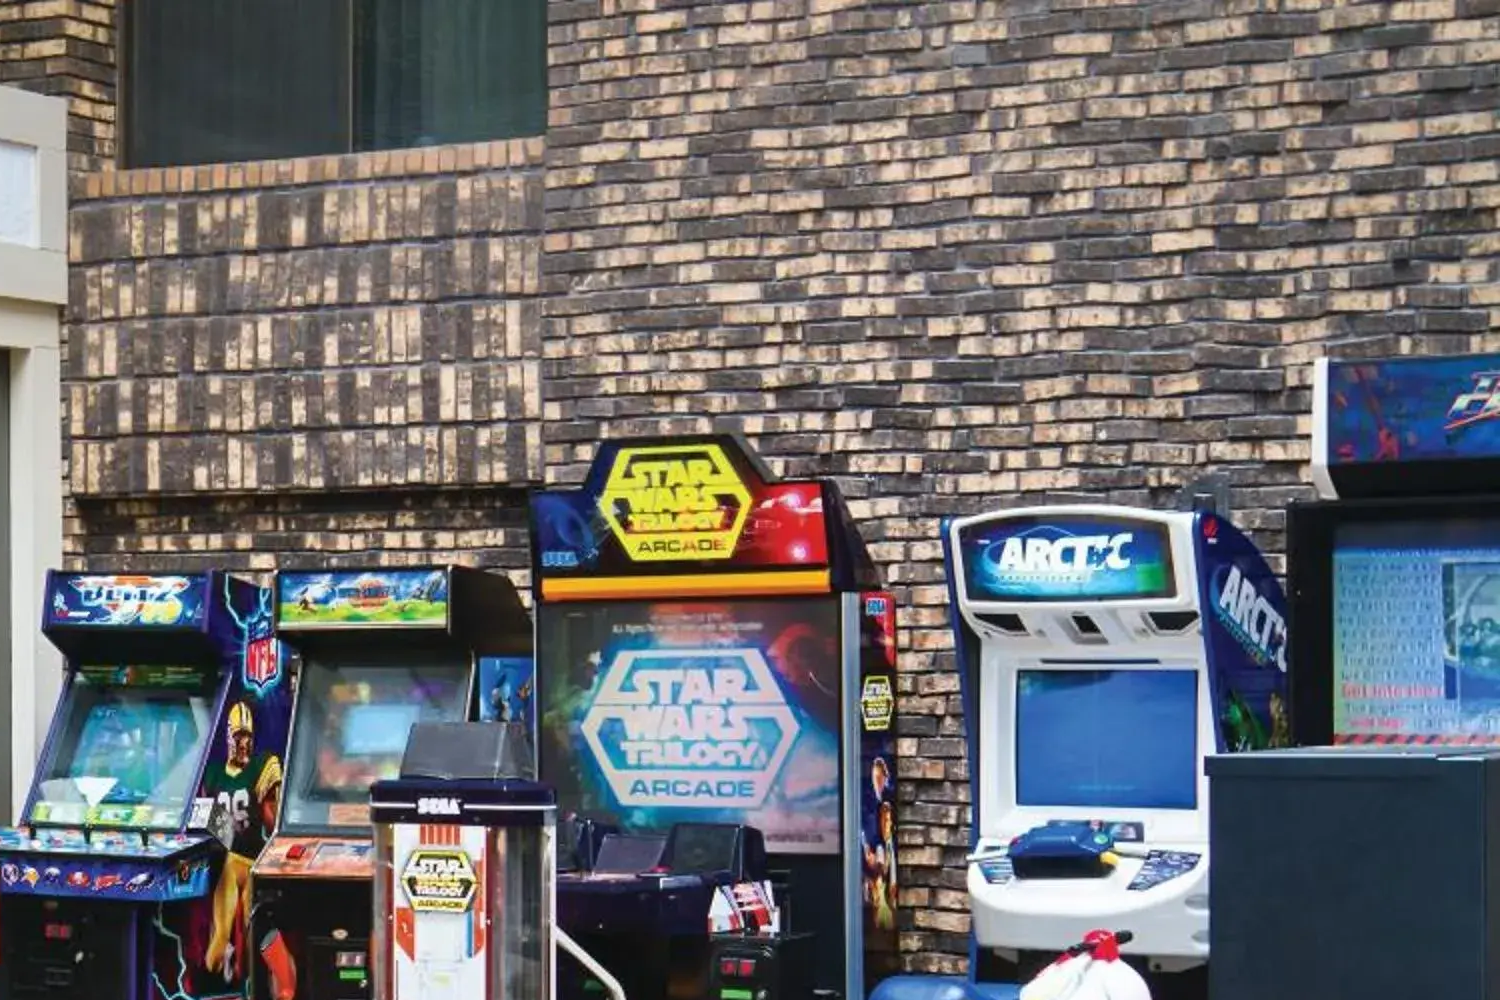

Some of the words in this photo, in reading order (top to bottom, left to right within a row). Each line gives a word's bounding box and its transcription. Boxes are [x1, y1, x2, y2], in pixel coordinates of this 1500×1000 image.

[622, 460, 722, 487] STAR
[626, 487, 720, 512] WARS
[626, 511, 725, 531] TRILOGY
[637, 538, 728, 553] ARCADE
[998, 532, 1134, 572] ARCTIC
[628, 668, 752, 705] STAR
[622, 704, 750, 741] WARS
[619, 741, 761, 766] TRILOGY
[629, 779, 757, 798] ARCADE
[417, 797, 461, 815] SEGA
[406, 857, 470, 876] STAR
